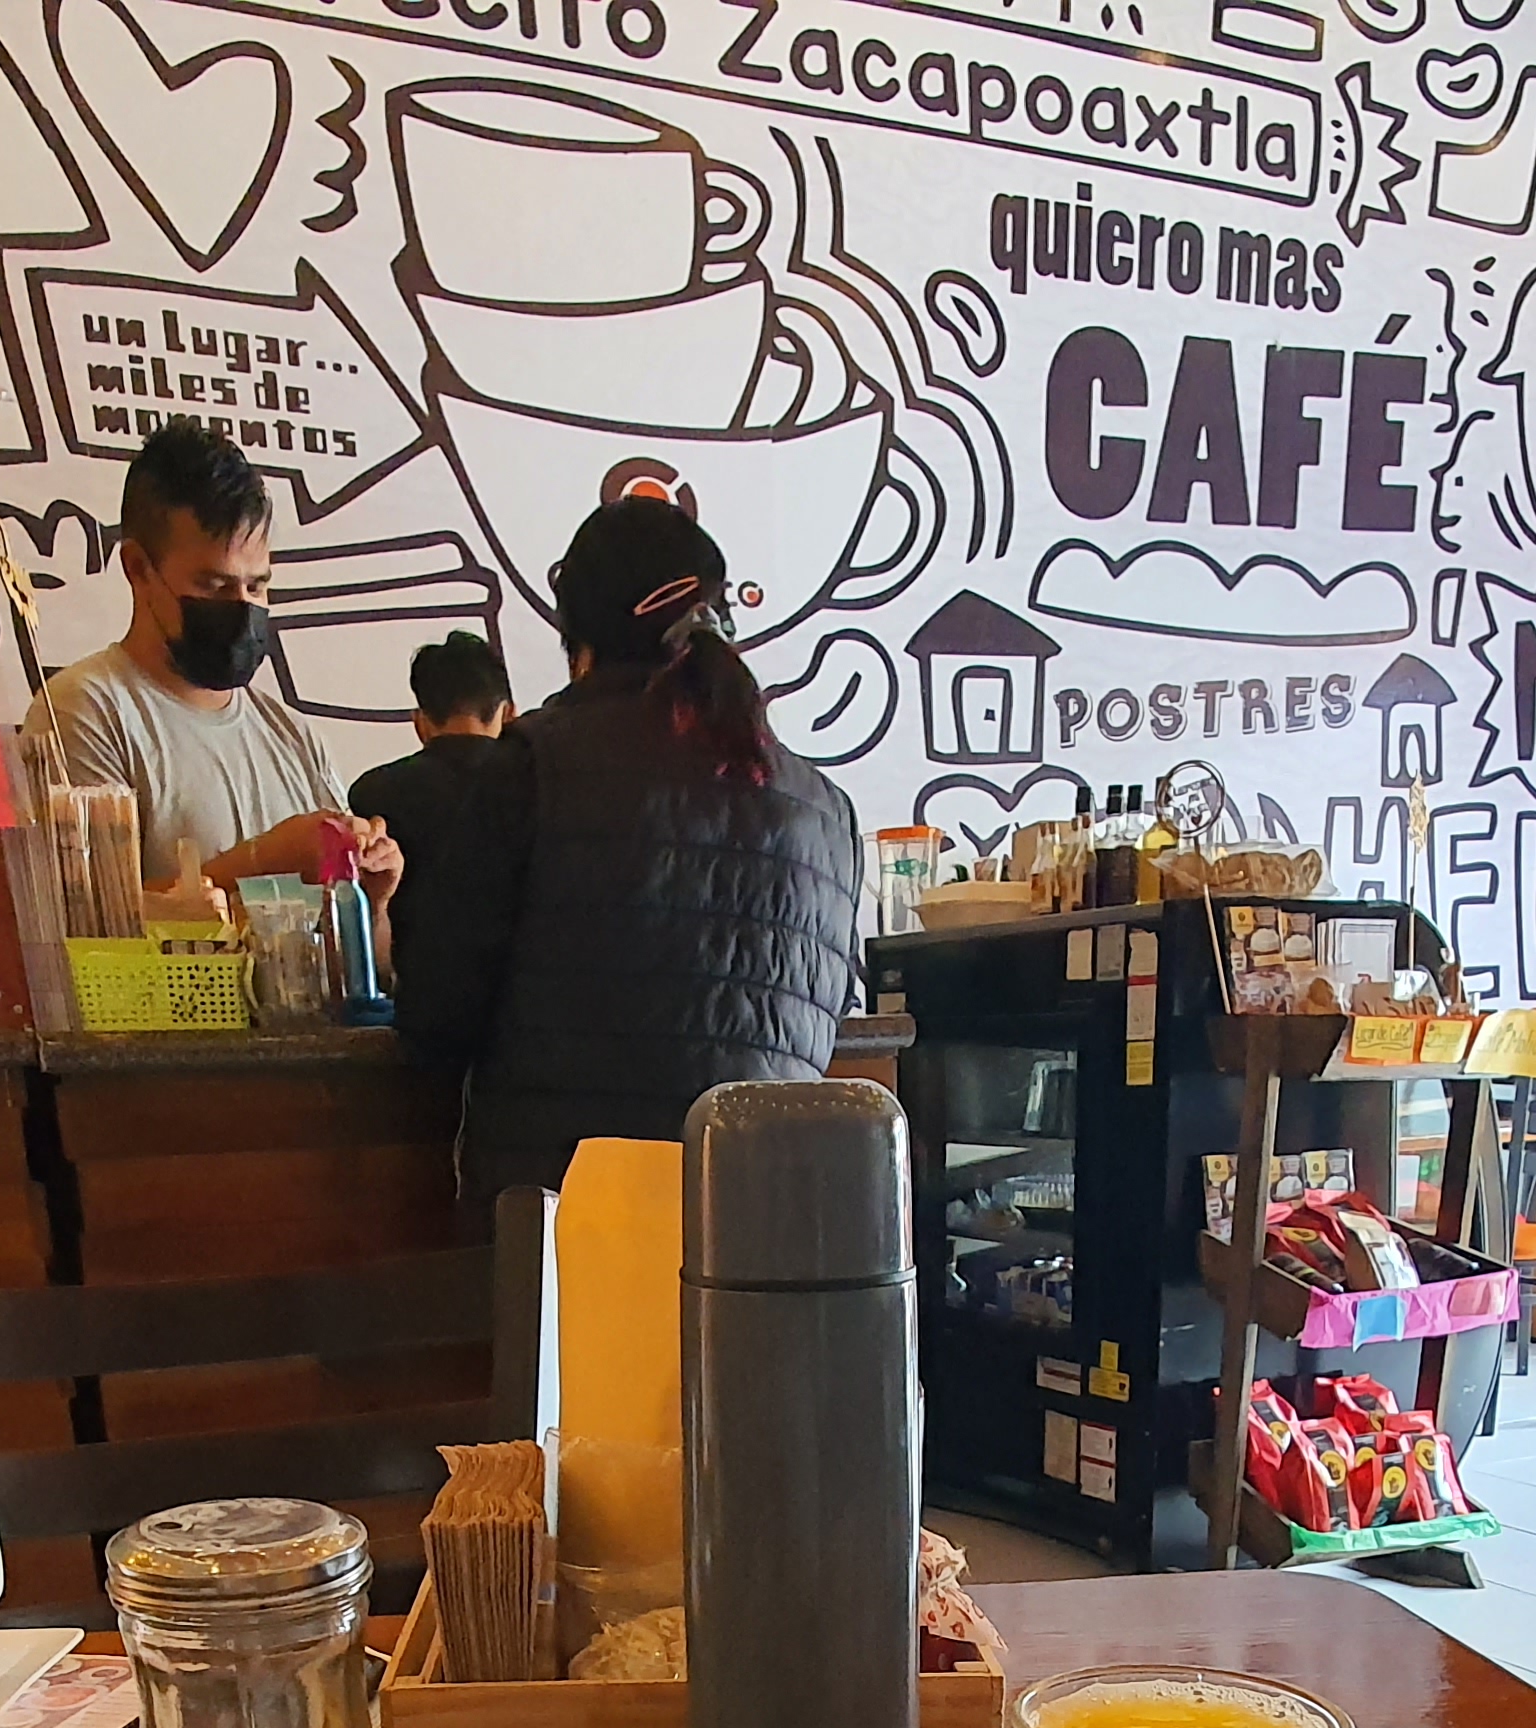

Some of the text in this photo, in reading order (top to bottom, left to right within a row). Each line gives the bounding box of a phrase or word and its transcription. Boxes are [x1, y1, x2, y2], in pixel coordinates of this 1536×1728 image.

[718, 0, 1298, 182] Zacapoaxtla
[990, 183, 1345, 313] quiero mas
[82, 309, 359, 375] un lugar...
[87, 353, 311, 415] miles de
[1045, 314, 1427, 533] CAFÉ
[1053, 672, 1358, 749] POSTRES
